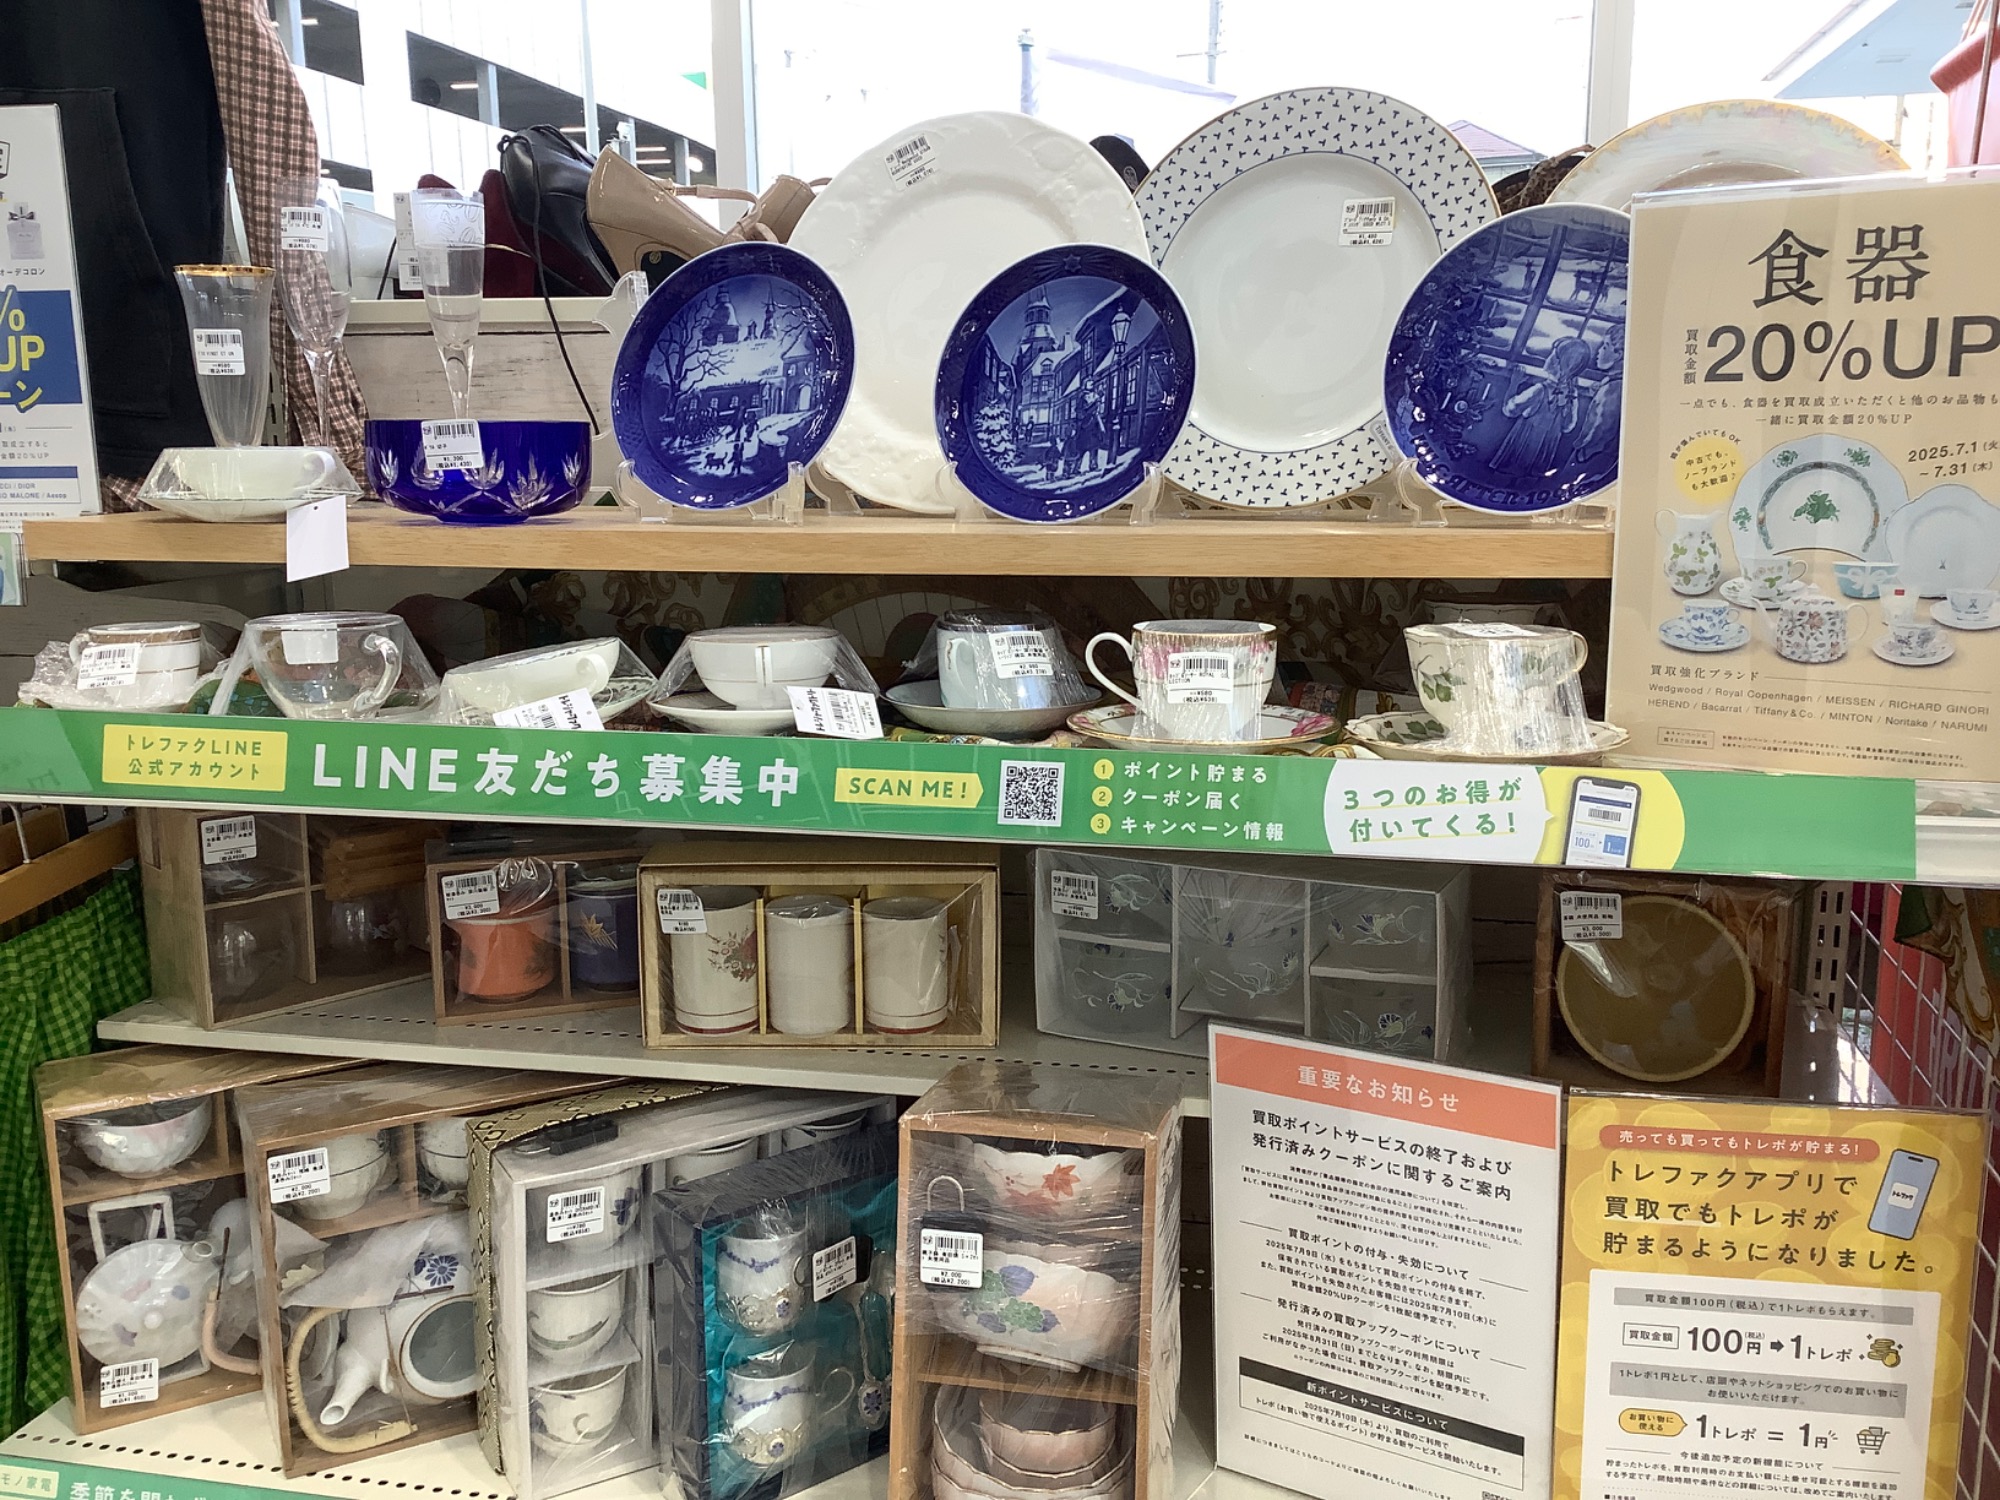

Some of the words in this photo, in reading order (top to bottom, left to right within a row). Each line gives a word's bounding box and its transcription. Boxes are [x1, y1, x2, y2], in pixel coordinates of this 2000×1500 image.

[1748, 224, 1930, 309] 食器
[1683, 328, 1700, 386] 買取金額
[1703, 315, 2000, 383] 20%UP
[10, 491, 41, 499] MALONE
[1651, 664, 1759, 681] 買取強化ブランド
[1649, 683, 1703, 695] Wedgwood
[1715, 687, 1743, 698] Royal
[1747, 690, 1812, 703] Copenhagen
[1826, 696, 1875, 707] MEISSEN
[1889, 700, 1942, 712] RICHARD
[1946, 705, 1989, 715] GINORI
[1648, 699, 1690, 709] HEREND
[1701, 702, 1742, 713] Bacarrat
[1829, 712, 1873, 723] MINTON
[1885, 717, 1928, 728] Noritake
[1941, 722, 1988, 732] NARUMI
[127, 734, 262, 757] トレファクLINE
[129, 758, 260, 781] 公式アカウント
[1123, 760, 1269, 784] ポイント貯まる
[849, 777, 914, 798] SCAN
[1122, 788, 1242, 812] クーポン届く
[1343, 780, 1523, 812] 3つのお得が
[1120, 816, 1285, 842] キャンペーン情報
[1349, 811, 1517, 844] 付いてくる！
[1297, 1065, 1460, 1113] 重要なお知らせ
[1252, 1108, 1513, 1176] 買取ポイントサービスの終了および
[1619, 1129, 1860, 1156] 売っても買ってもトレポが貯まる！
[1252, 1132, 1512, 1202] 発行済みクーポンに関するご案内
[1609, 1160, 1857, 1196] トレファクアプリで
[1604, 1196, 1838, 1230] 買取でもトレポが
[1288, 1227, 1469, 1280] 買取ポイントの付与・失効について
[1602, 1232, 1936, 1275] 貯まるようになりました。
[1277, 1297, 1481, 1359] 発行済みの買取アップクーポンについて
[1297, 1319, 1455, 1368] 発行済みの買取アップクーポンの利用期限は
[1629, 1329, 1673, 1343] 買取金額
[1306, 1381, 1448, 1431] 新ポイントサービスについて
[1707, 1388, 1806, 1405] お使いいただけます。
[1629, 1413, 1674, 1424] お買い物に
[1639, 1422, 1664, 1432] 使える
[1680, 1450, 1824, 1471] 今後追加予定の新機能について
